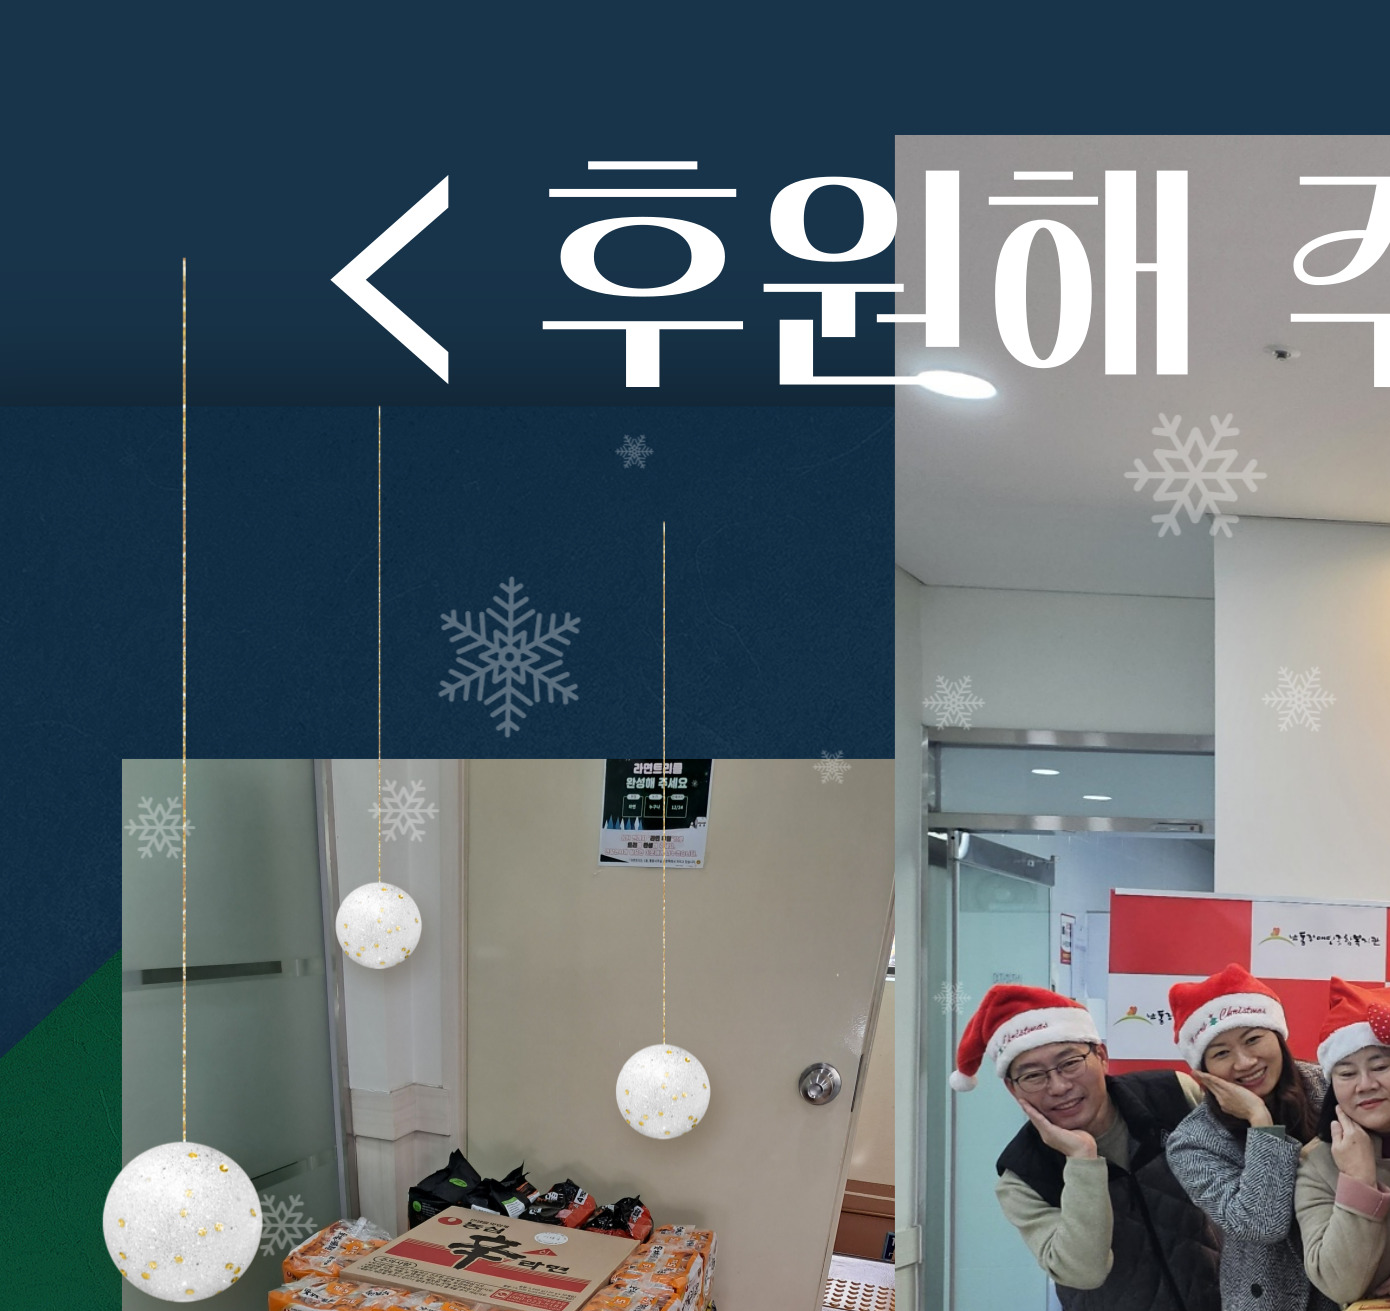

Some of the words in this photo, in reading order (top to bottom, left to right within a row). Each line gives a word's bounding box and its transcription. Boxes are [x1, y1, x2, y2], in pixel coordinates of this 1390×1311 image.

[462, 1220, 505, 1236] 농심
[448, 1235, 527, 1270] 辛
[516, 1259, 571, 1276] 라면
